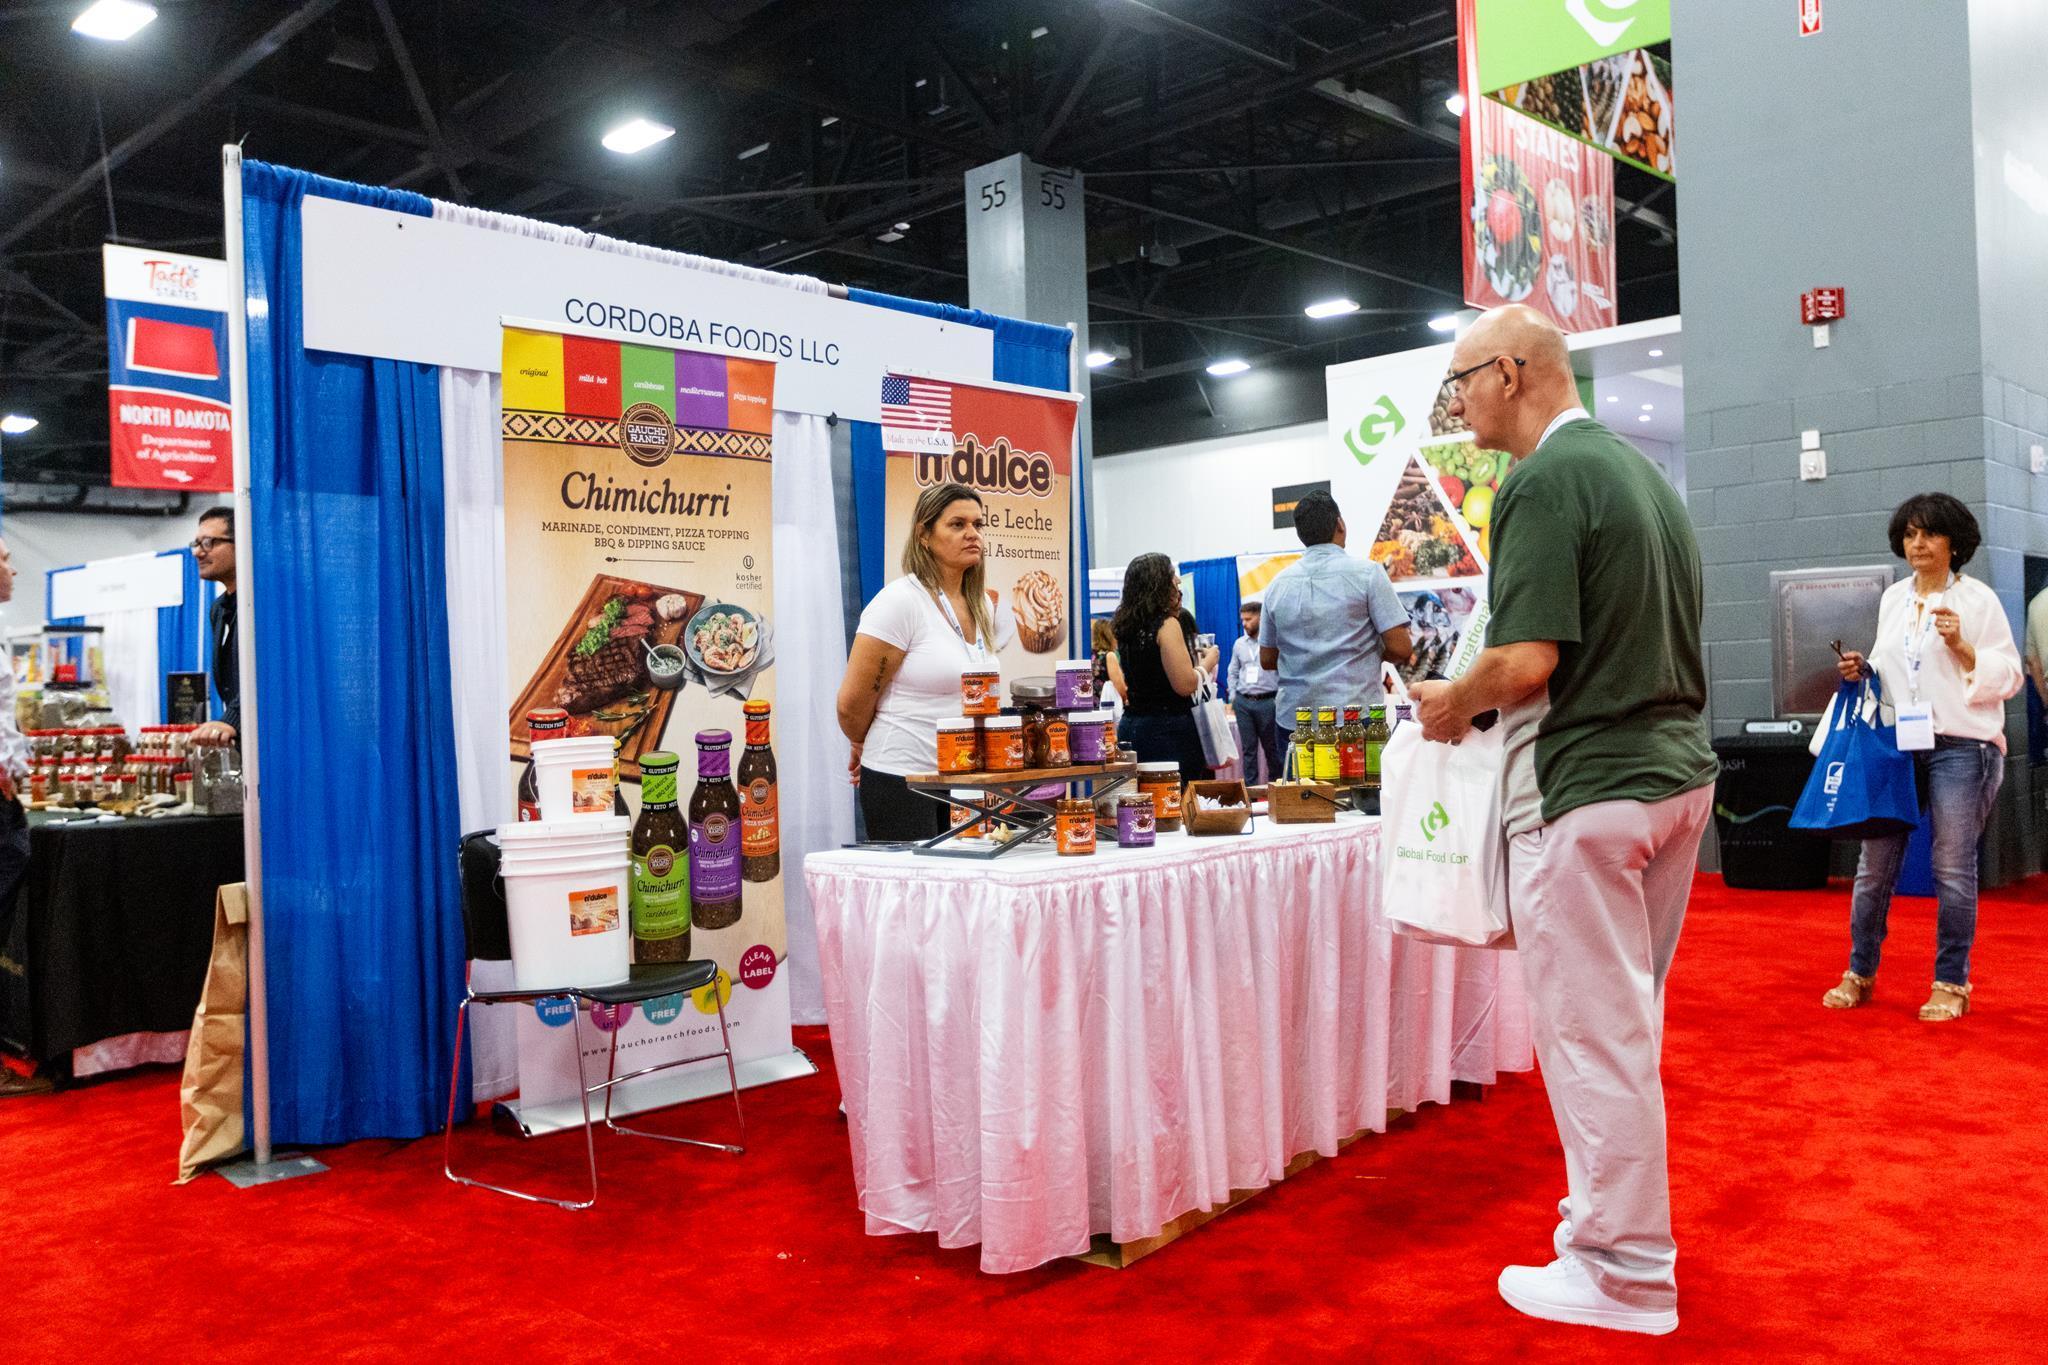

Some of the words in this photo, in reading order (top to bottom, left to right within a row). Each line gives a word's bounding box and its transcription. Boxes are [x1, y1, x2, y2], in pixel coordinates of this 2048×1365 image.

[981, 180, 1006, 212] 55
[1041, 181, 1065, 211] 55
[144, 260, 198, 290] Taste
[565, 298, 702, 343] CORDOBA
[709, 321, 793, 358] FOODS
[800, 338, 840, 365] LLC
[520, 368, 549, 378] original
[578, 374, 595, 383] mild
[597, 376, 608, 385] hot
[634, 381, 665, 391] caribbean
[120, 404, 171, 427] NORTH
[174, 410, 231, 432] DAKOTA
[627, 424, 668, 437] GAUCHO
[887, 433, 905, 444] Made
[141, 433, 212, 450] Department
[630, 433, 666, 445] RANCH
[136, 450, 151, 460] of
[152, 451, 217, 465] Agriculture
[919, 440, 1050, 492] ndulce
[561, 471, 732, 517] Chimichurri
[982, 505, 1000, 527] de
[1005, 508, 1053, 531] Leche
[542, 521, 604, 535] MARINADE,
[606, 525, 673, 538] CONDIMENT,
[675, 528, 705, 539] PIZZA
[708, 528, 750, 540] TOPPING
[594, 538, 616, 549] BBQ
[617, 538, 626, 548] &
[627, 538, 670, 550] DIPPING
[671, 540, 706, 551] SAUCE
[995, 543, 1061, 561] Assortment
[736, 573, 762, 582] kosher
[736, 581, 763, 590] certified
[1450, 599, 1491, 681] ternational
[1069, 816, 1091, 824] n'dulce
[1396, 846, 1424, 860] Global
[1426, 850, 1446, 863] Food
[744, 951, 771, 967] CLEAN
[744, 967, 774, 979] LABEL
[545, 1003, 572, 1016] FREE
[651, 1008, 676, 1020] FREE
[582, 1020, 741, 1057] www.gauchoranchfoods.om
